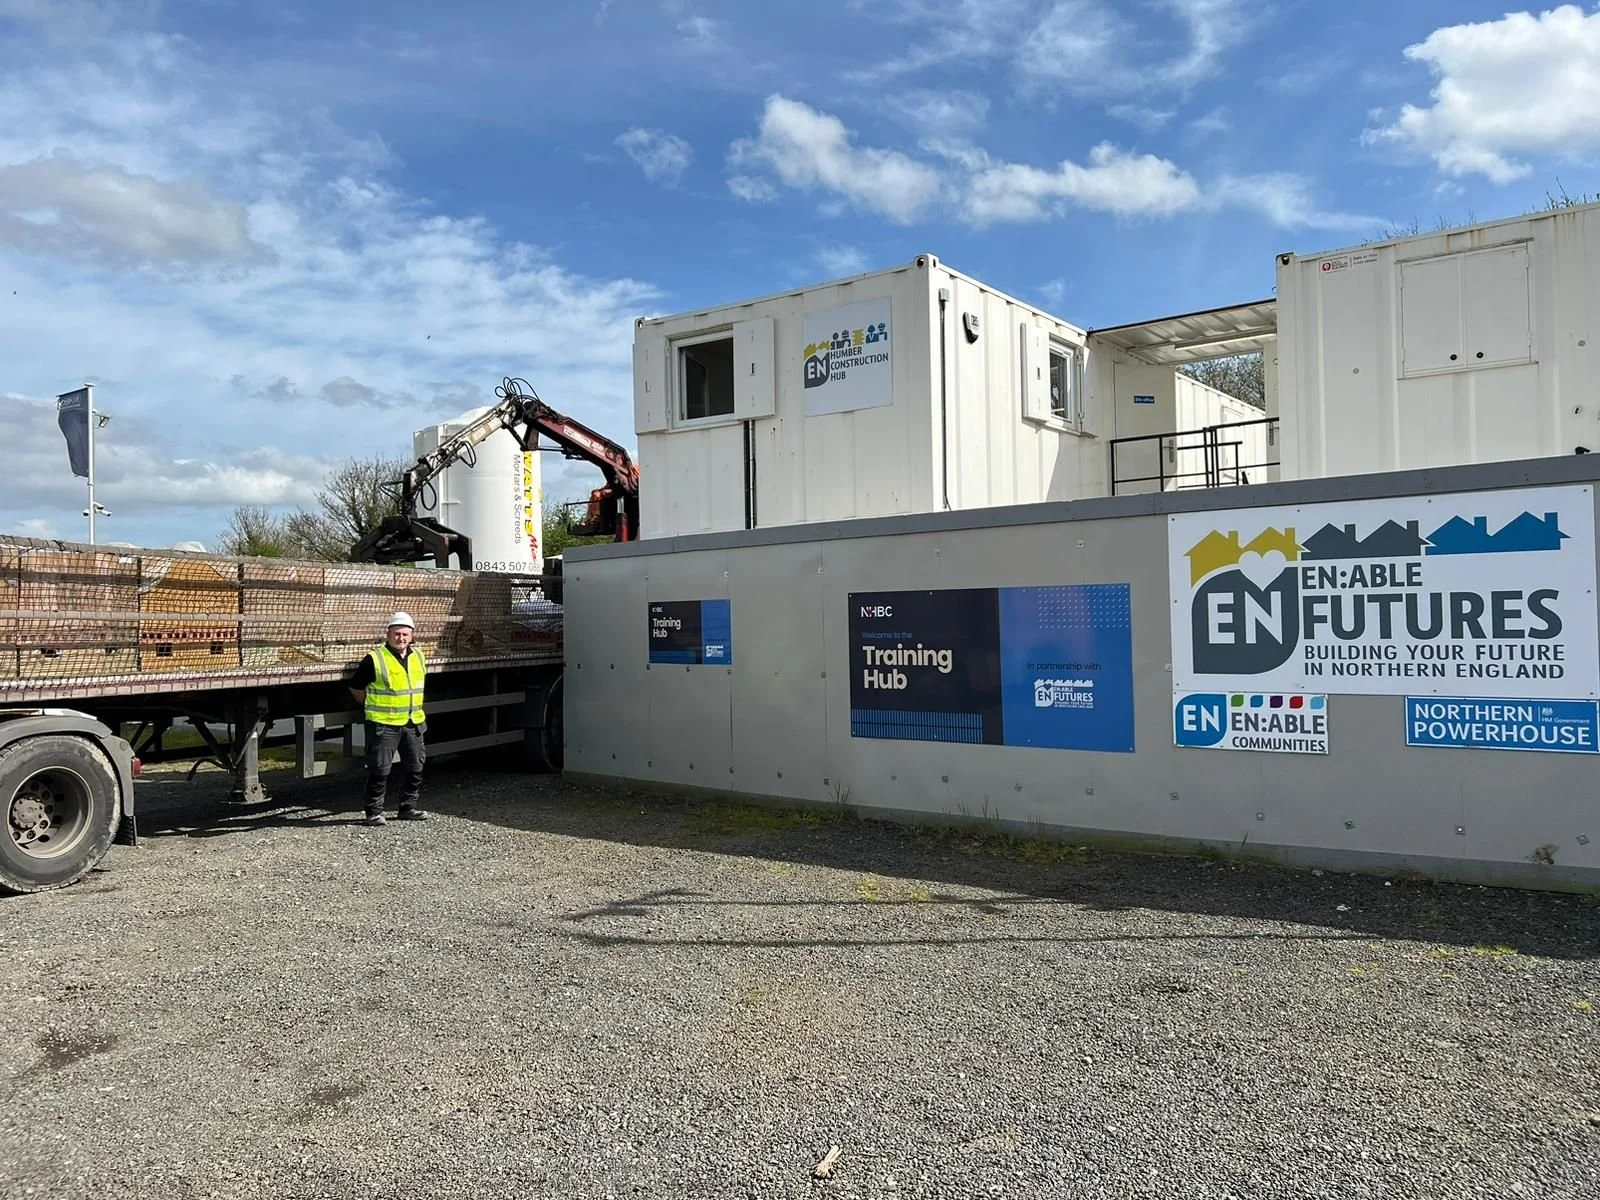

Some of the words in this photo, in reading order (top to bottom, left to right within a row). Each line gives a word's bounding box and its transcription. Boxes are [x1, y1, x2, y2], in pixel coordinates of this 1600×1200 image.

[831, 346, 862, 360] HUMBER
[831, 352, 889, 370] CONSTRUCTION
[807, 360, 827, 380] EN
[831, 371, 846, 381] HUB
[513, 454, 521, 492] Mortars
[514, 503, 522, 544] Screeds
[475, 561, 506, 571] 0843
[509, 561, 526, 571] 507
[1302, 562, 1423, 590] EN:ABLE
[861, 606, 893, 617] NHBC
[1207, 590, 1283, 645] EN
[1303, 589, 1563, 641] FUTURES
[652, 617, 681, 630] Training
[652, 628, 668, 638] Hub
[862, 643, 953, 674] Training
[1304, 645, 1397, 661] BUILDING
[1406, 644, 1464, 661] YOUR
[1476, 644, 1565, 661] FUTURE
[1036, 662, 1083, 672] partnership
[1304, 662, 1323, 676] IN
[1331, 662, 1446, 678] NORTHERN
[1456, 664, 1565, 679] ENGLAND
[863, 668, 908, 690] Hub
[1038, 690, 1052, 701] EN
[1054, 692, 1094, 702] FUTURES
[1182, 705, 1221, 732] EN
[1231, 712, 1326, 735] EN:ABLE
[1415, 703, 1533, 722] NORTHERN
[1413, 721, 1592, 746] POWERHOUSE
[1232, 736, 1327, 753] COMMUNITIES
